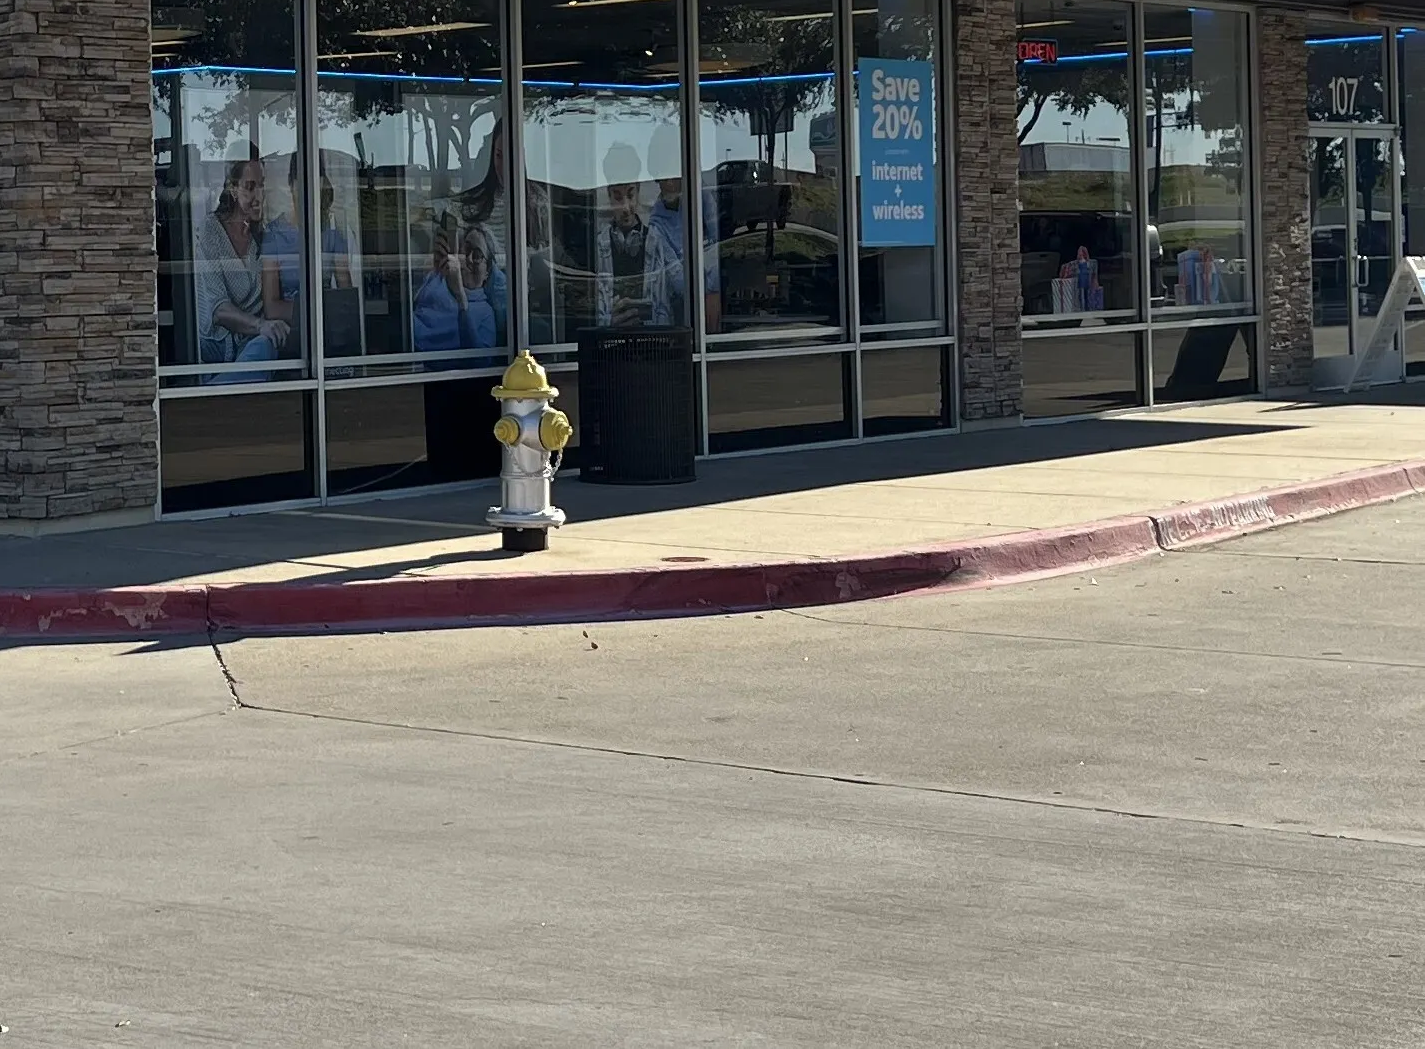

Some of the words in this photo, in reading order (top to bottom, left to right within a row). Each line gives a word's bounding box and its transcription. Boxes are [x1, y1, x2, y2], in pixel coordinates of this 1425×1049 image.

[1018, 41, 1056, 62] OPEN
[872, 69, 920, 102] Save
[1328, 76, 1358, 116] 107
[872, 103, 923, 140] 20%
[872, 159, 923, 181] internet
[872, 200, 924, 220] wireless
